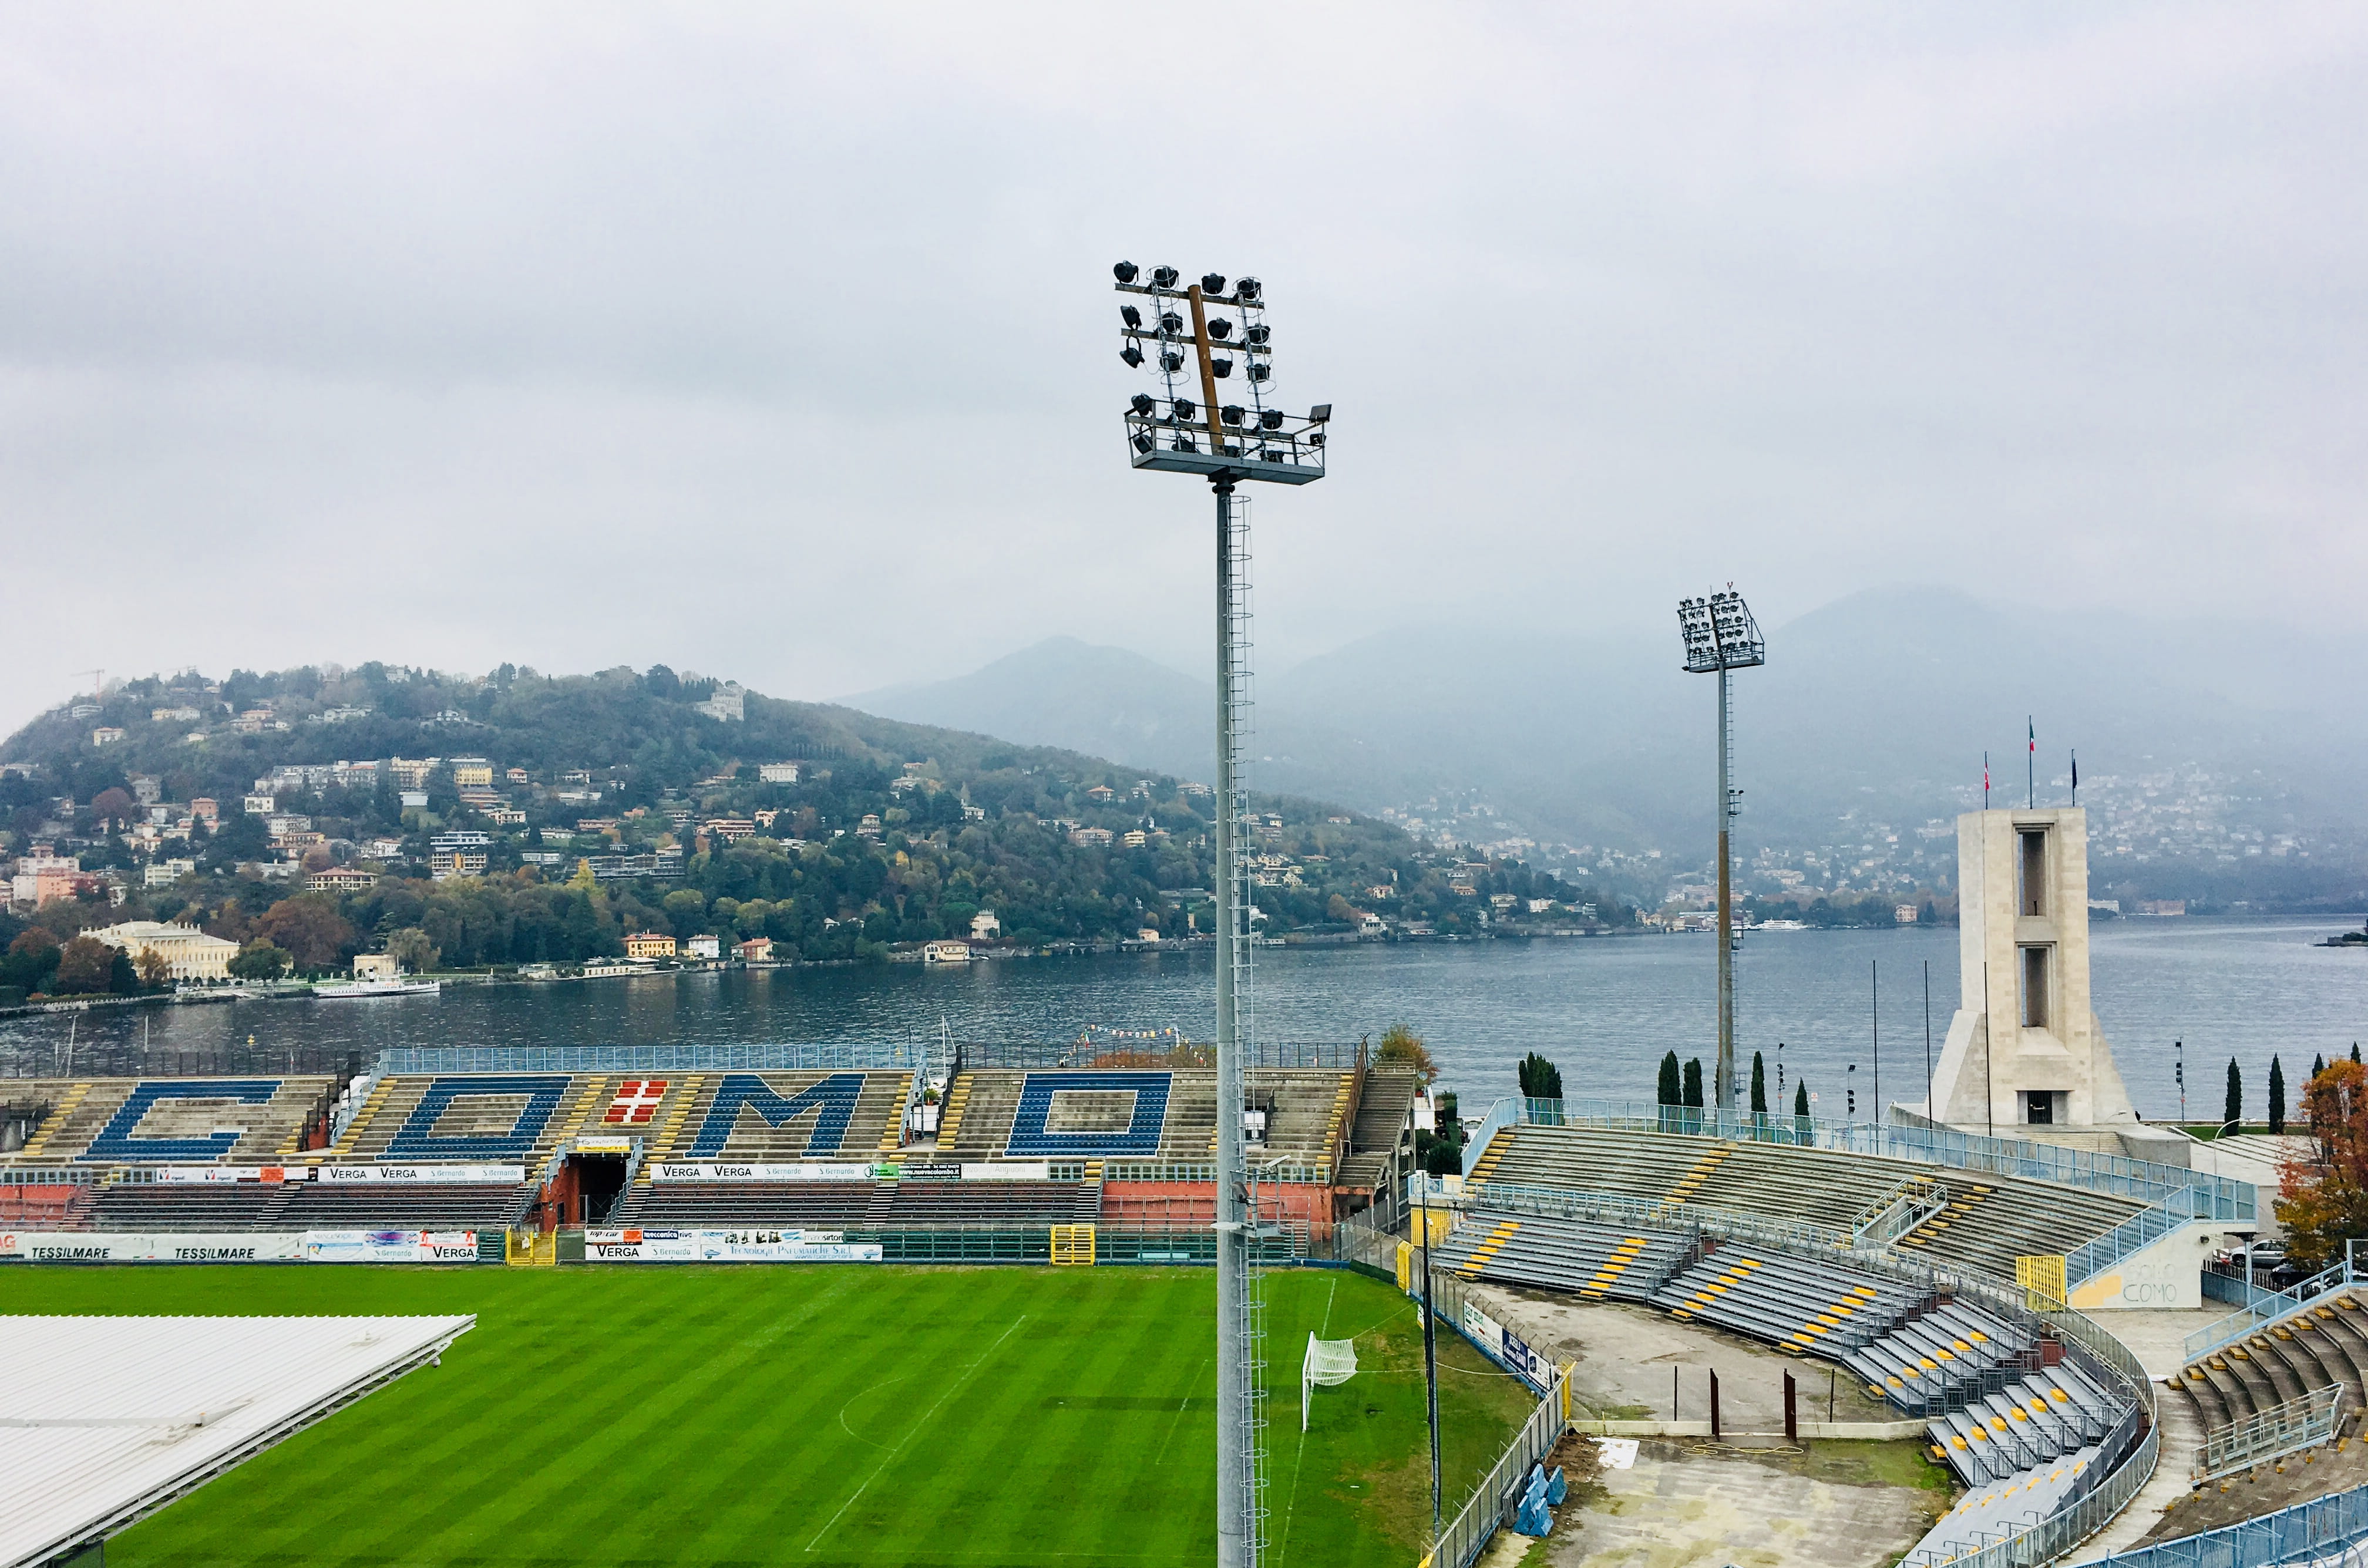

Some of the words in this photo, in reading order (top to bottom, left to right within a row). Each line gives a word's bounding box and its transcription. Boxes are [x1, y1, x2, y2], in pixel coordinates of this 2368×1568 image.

[32, 1247, 110, 1258] TESSILMARE
[176, 1248, 255, 1259] TESSILMARE
[433, 1246, 475, 1257] VERGA
[597, 1245, 639, 1257] VERGA
[2124, 1284, 2177, 1302] COMO
